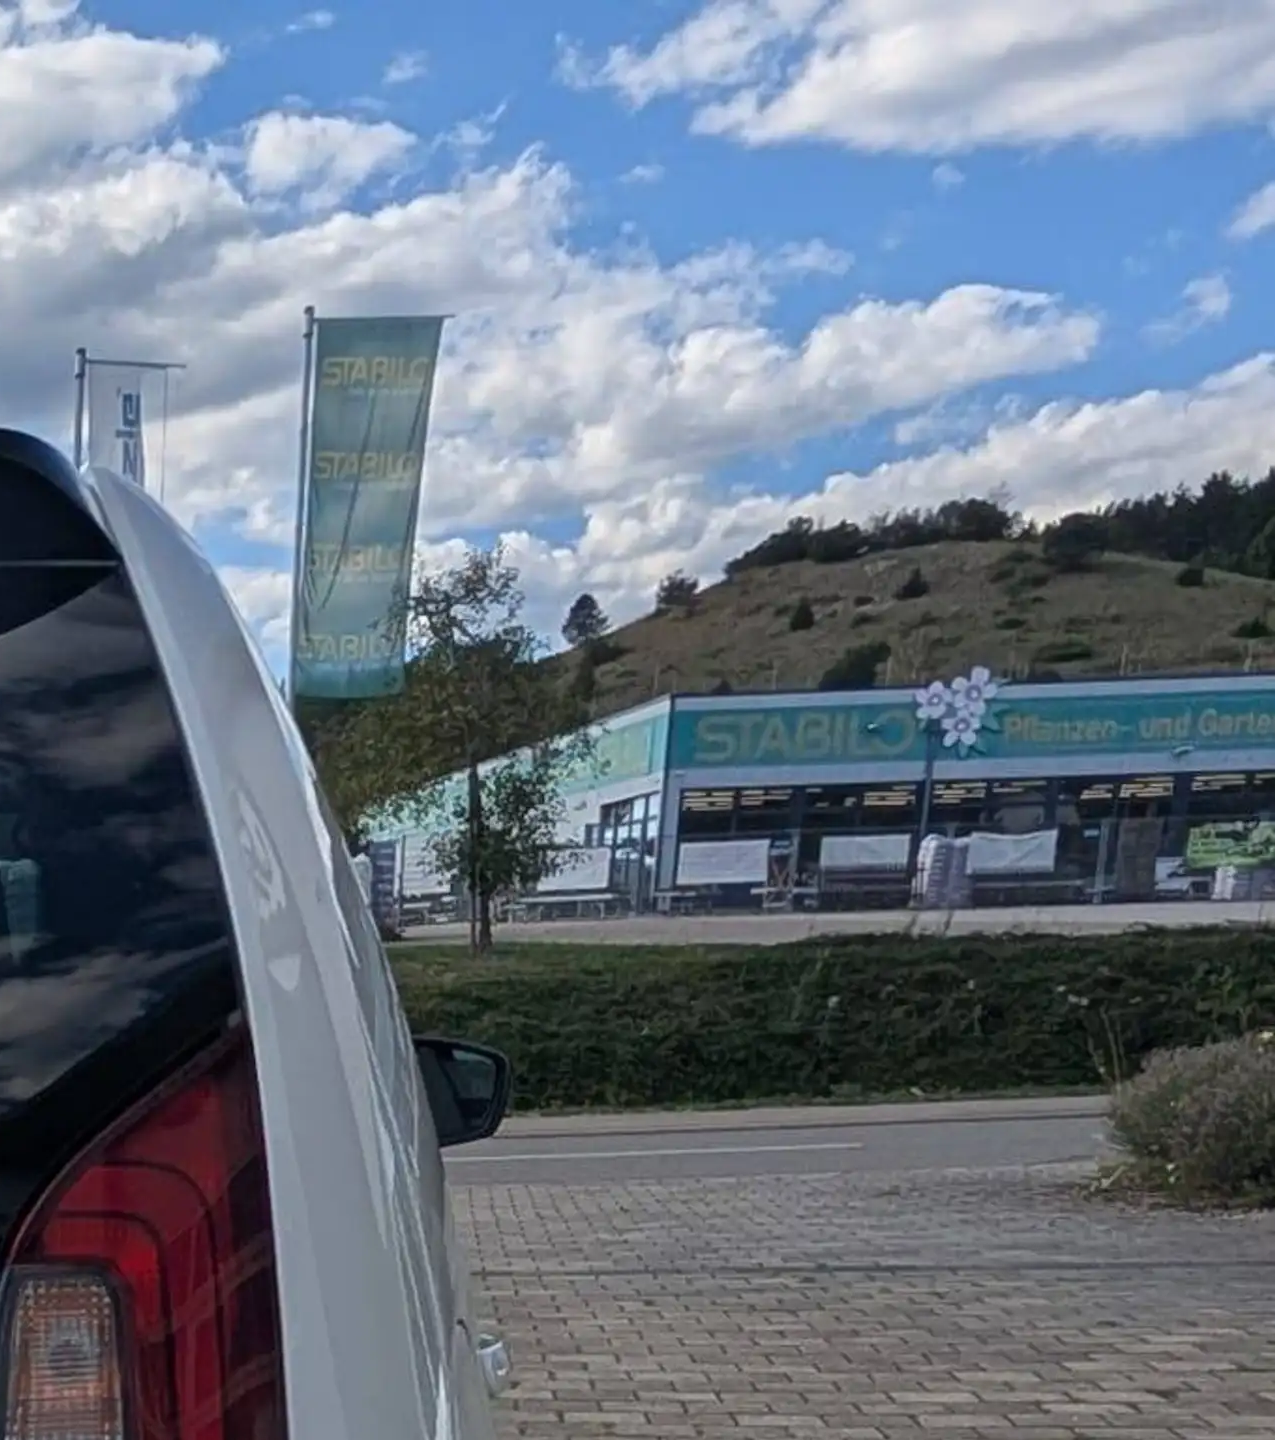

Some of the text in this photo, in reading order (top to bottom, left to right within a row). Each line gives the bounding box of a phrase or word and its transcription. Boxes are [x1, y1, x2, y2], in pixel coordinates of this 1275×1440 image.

[695, 708, 917, 763] STABILO
[1003, 713, 1132, 743] Pflanzen-
[1138, 711, 1192, 740] und
